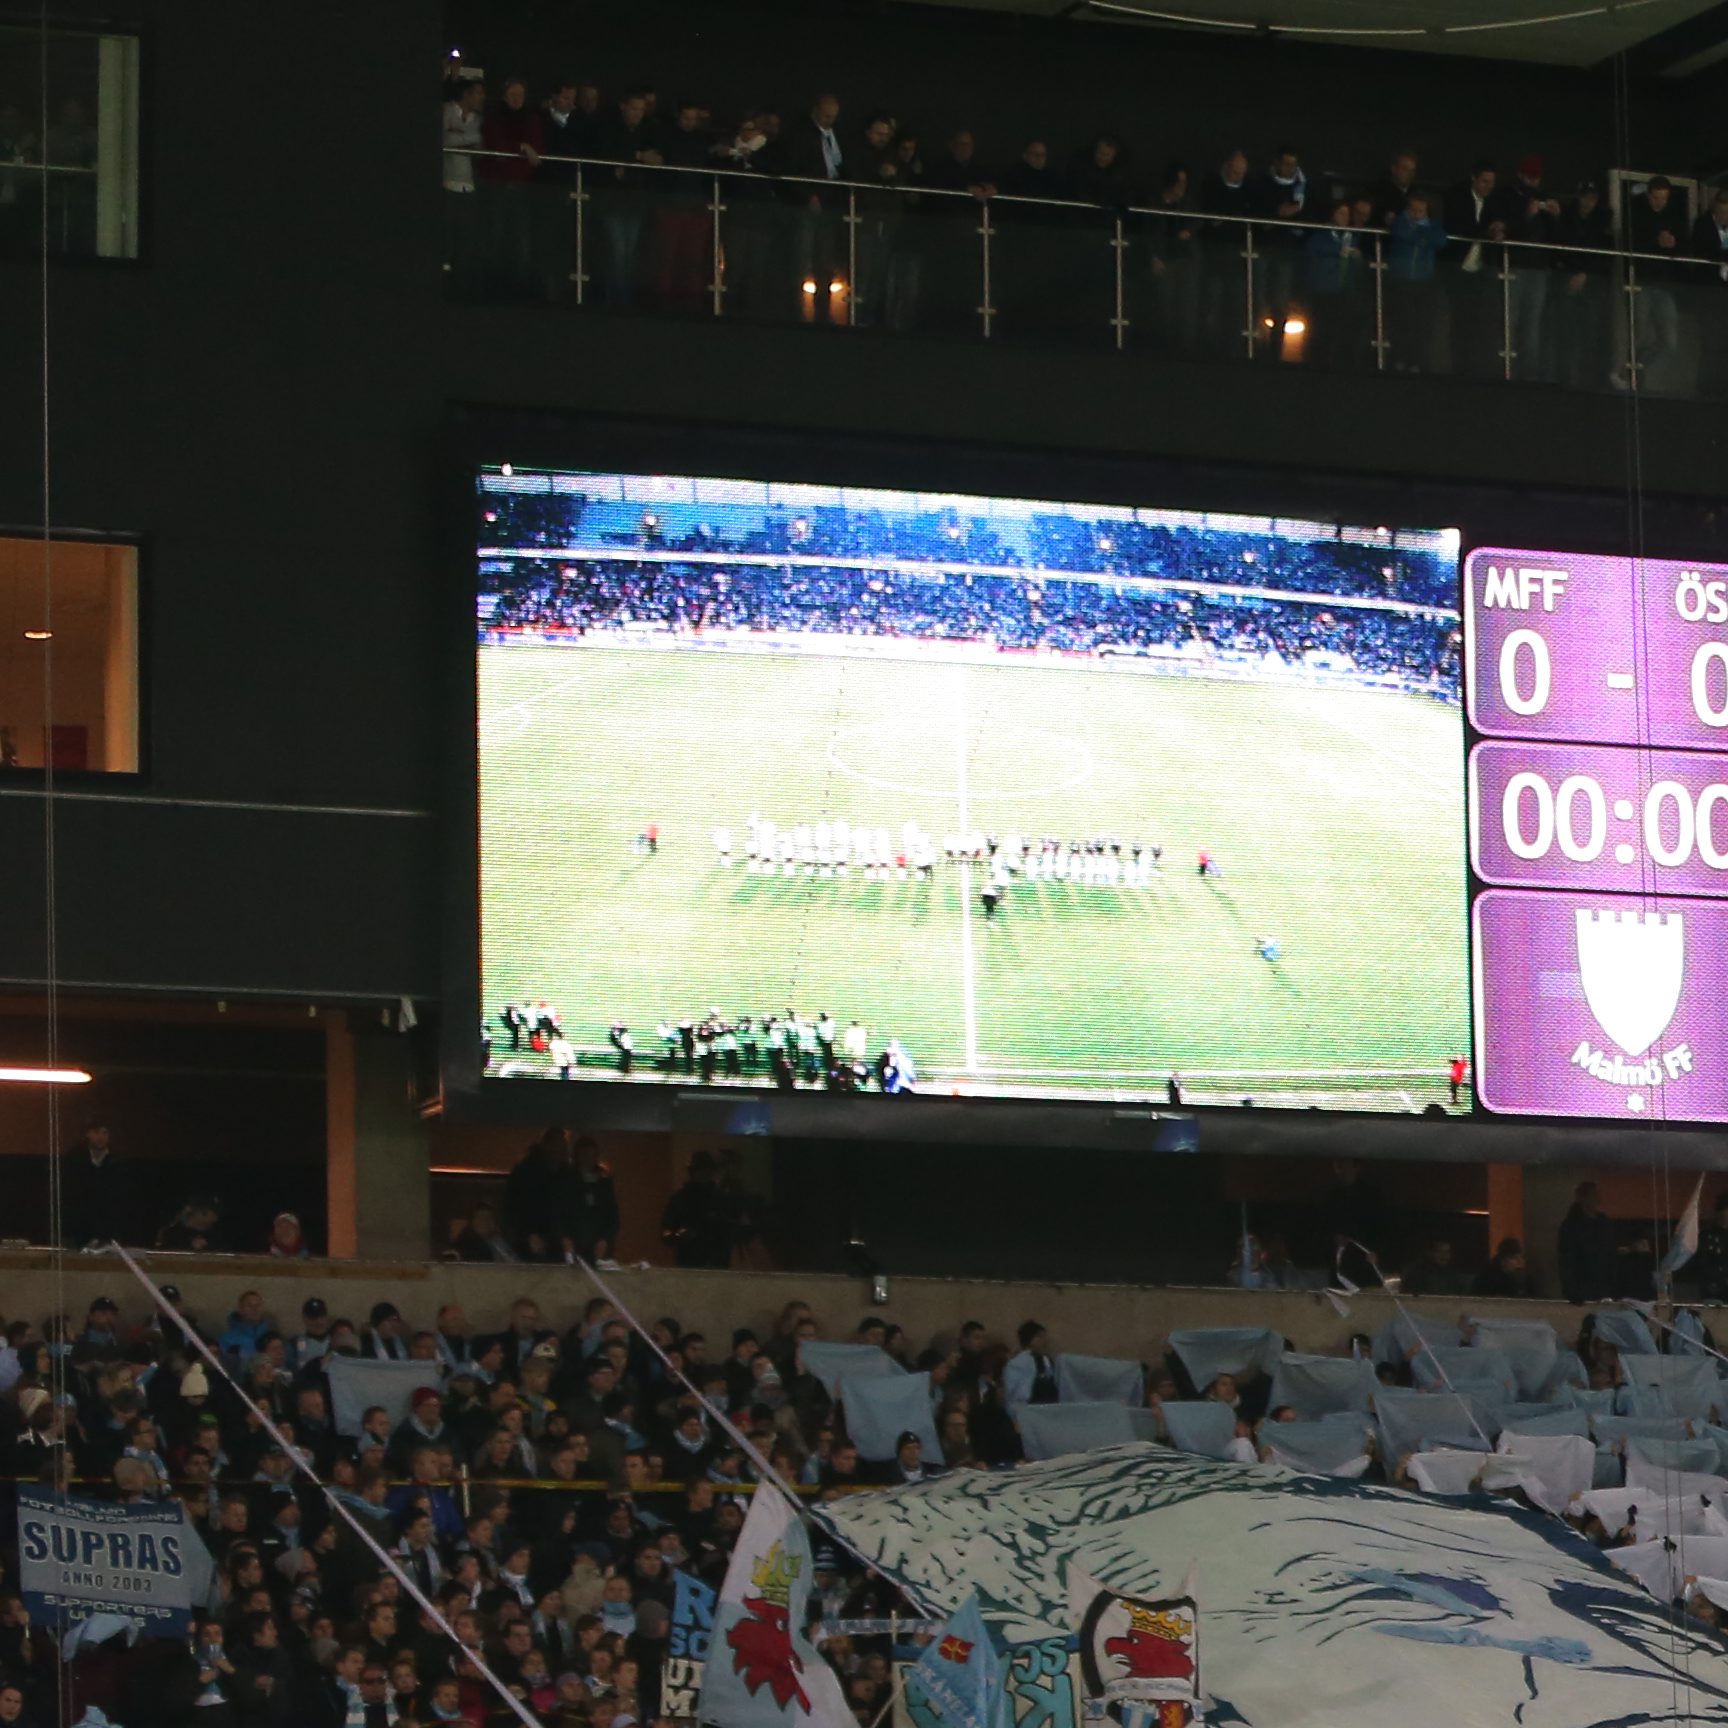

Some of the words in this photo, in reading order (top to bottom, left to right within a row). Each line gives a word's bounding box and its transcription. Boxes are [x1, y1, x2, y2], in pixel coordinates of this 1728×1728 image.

[1483, 566, 1568, 612] MFF
[1499, 628, 1551, 716] 0
[1570, 1040, 1663, 1086] Malmö
[1661, 1042, 1693, 1080] FF
[22, 1520, 184, 1579] SUPRAS
[62, 1570, 104, 1590] ANNO
